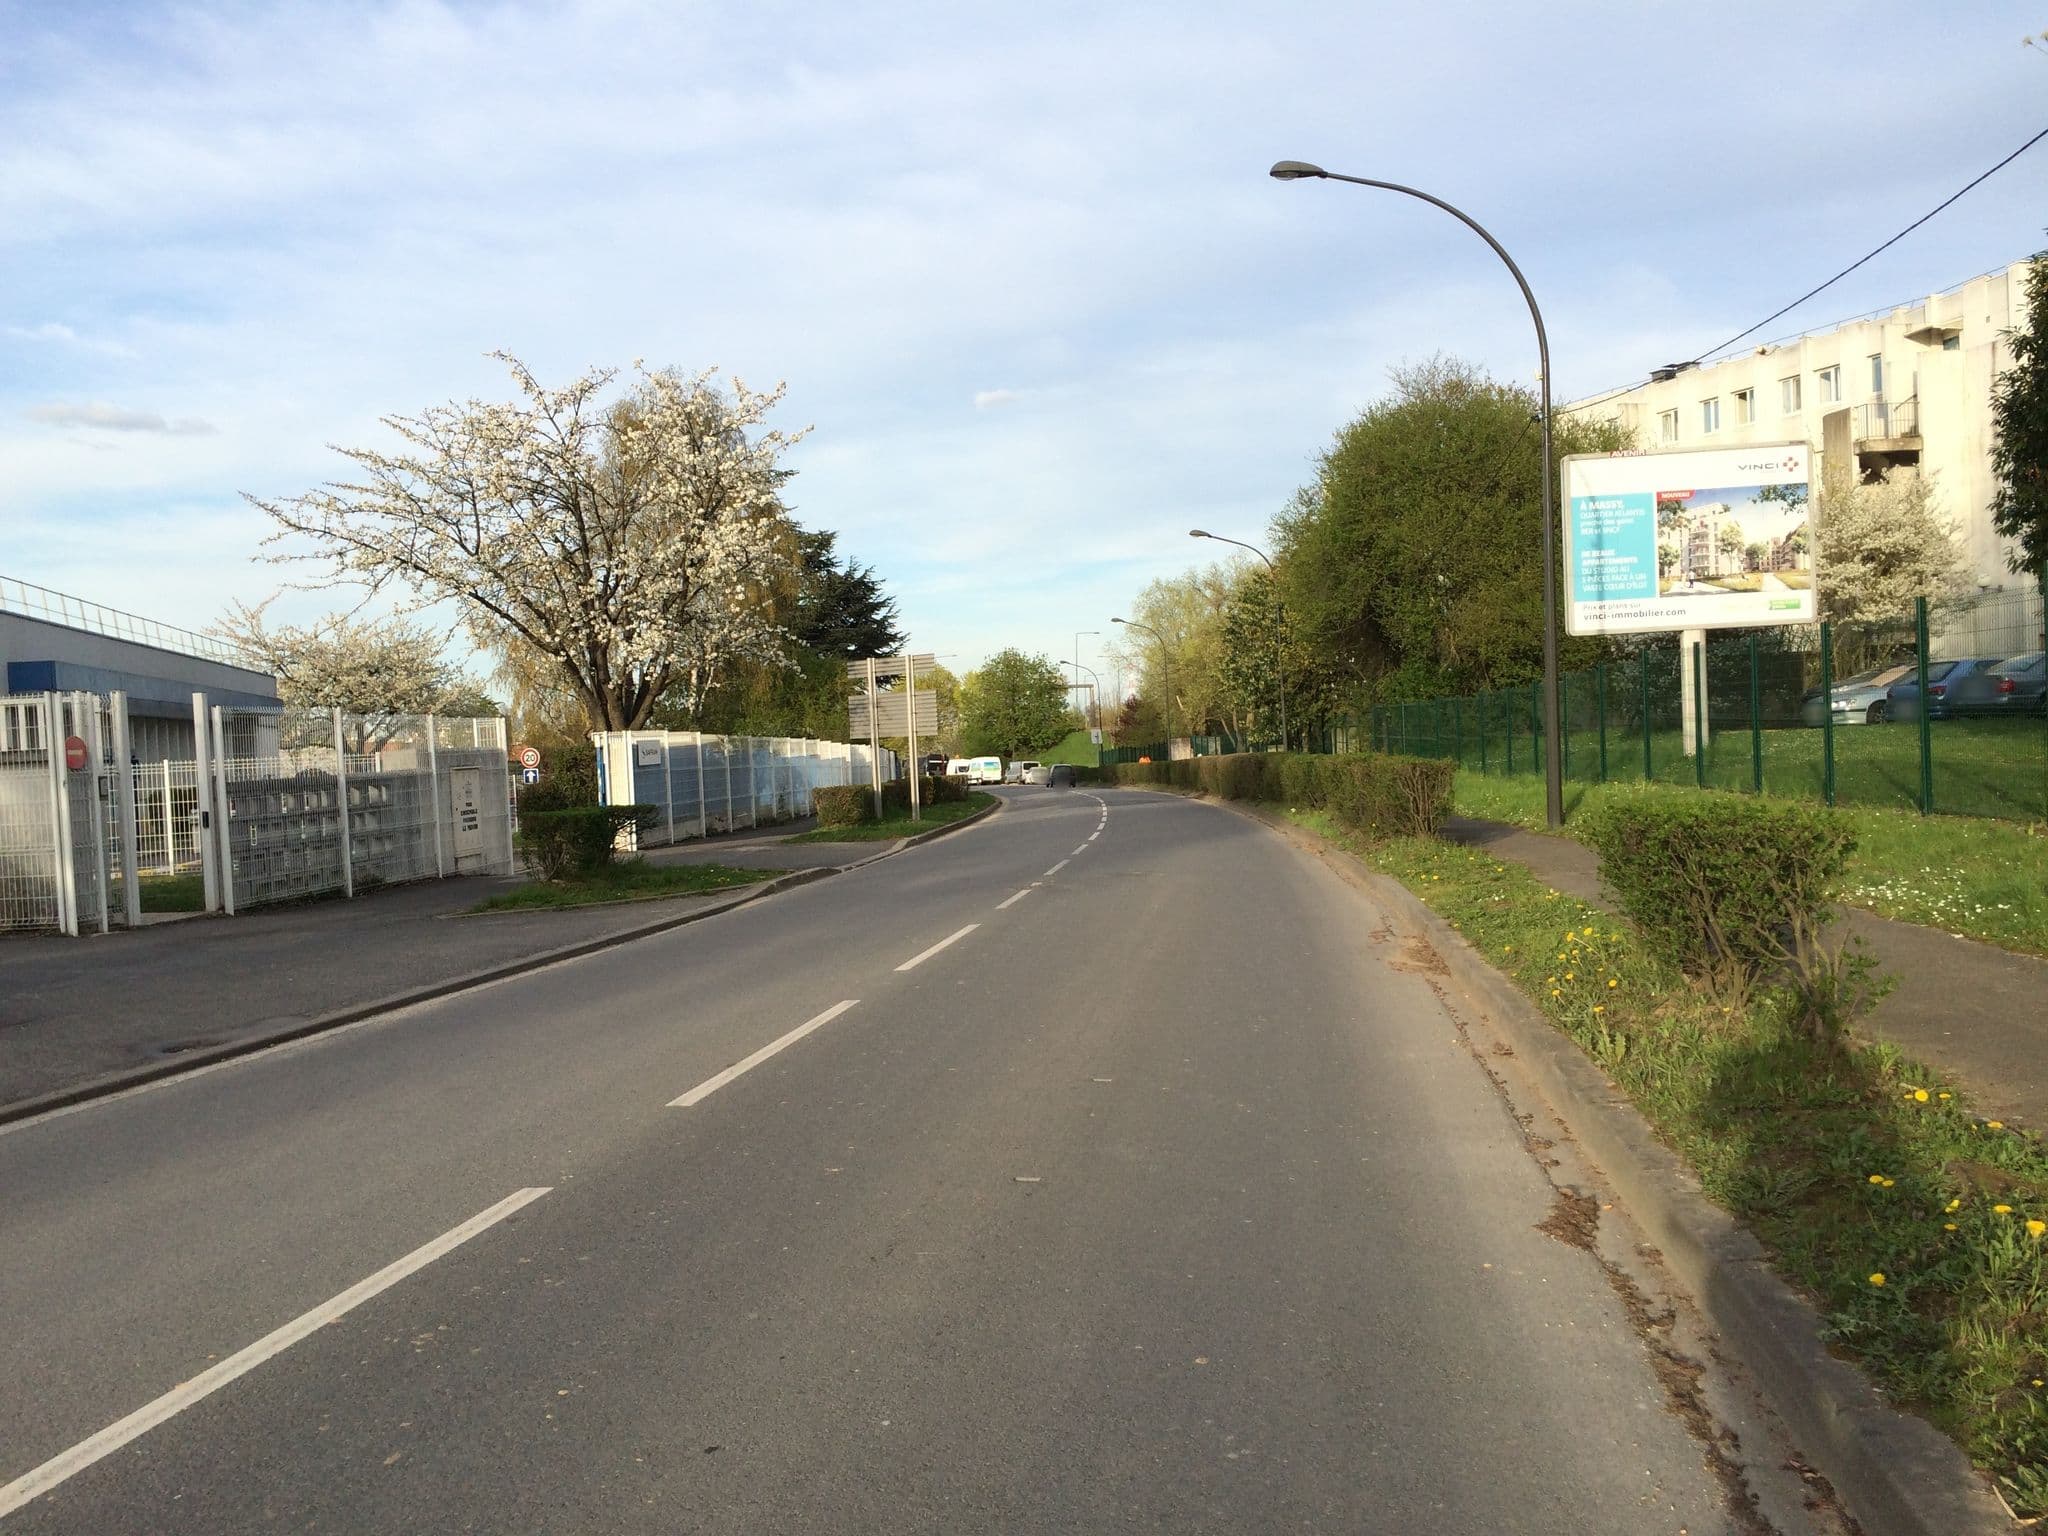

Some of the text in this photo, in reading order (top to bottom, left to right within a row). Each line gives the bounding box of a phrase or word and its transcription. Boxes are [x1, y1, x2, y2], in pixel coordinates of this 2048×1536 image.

[1611, 448, 1646, 458] AVENIR
[1738, 462, 1779, 471] VINCI
[1661, 491, 1690, 499] NOUVEAU
[1583, 608, 1687, 621] vinci-immobilier.com
[526, 753, 535, 762] 20
